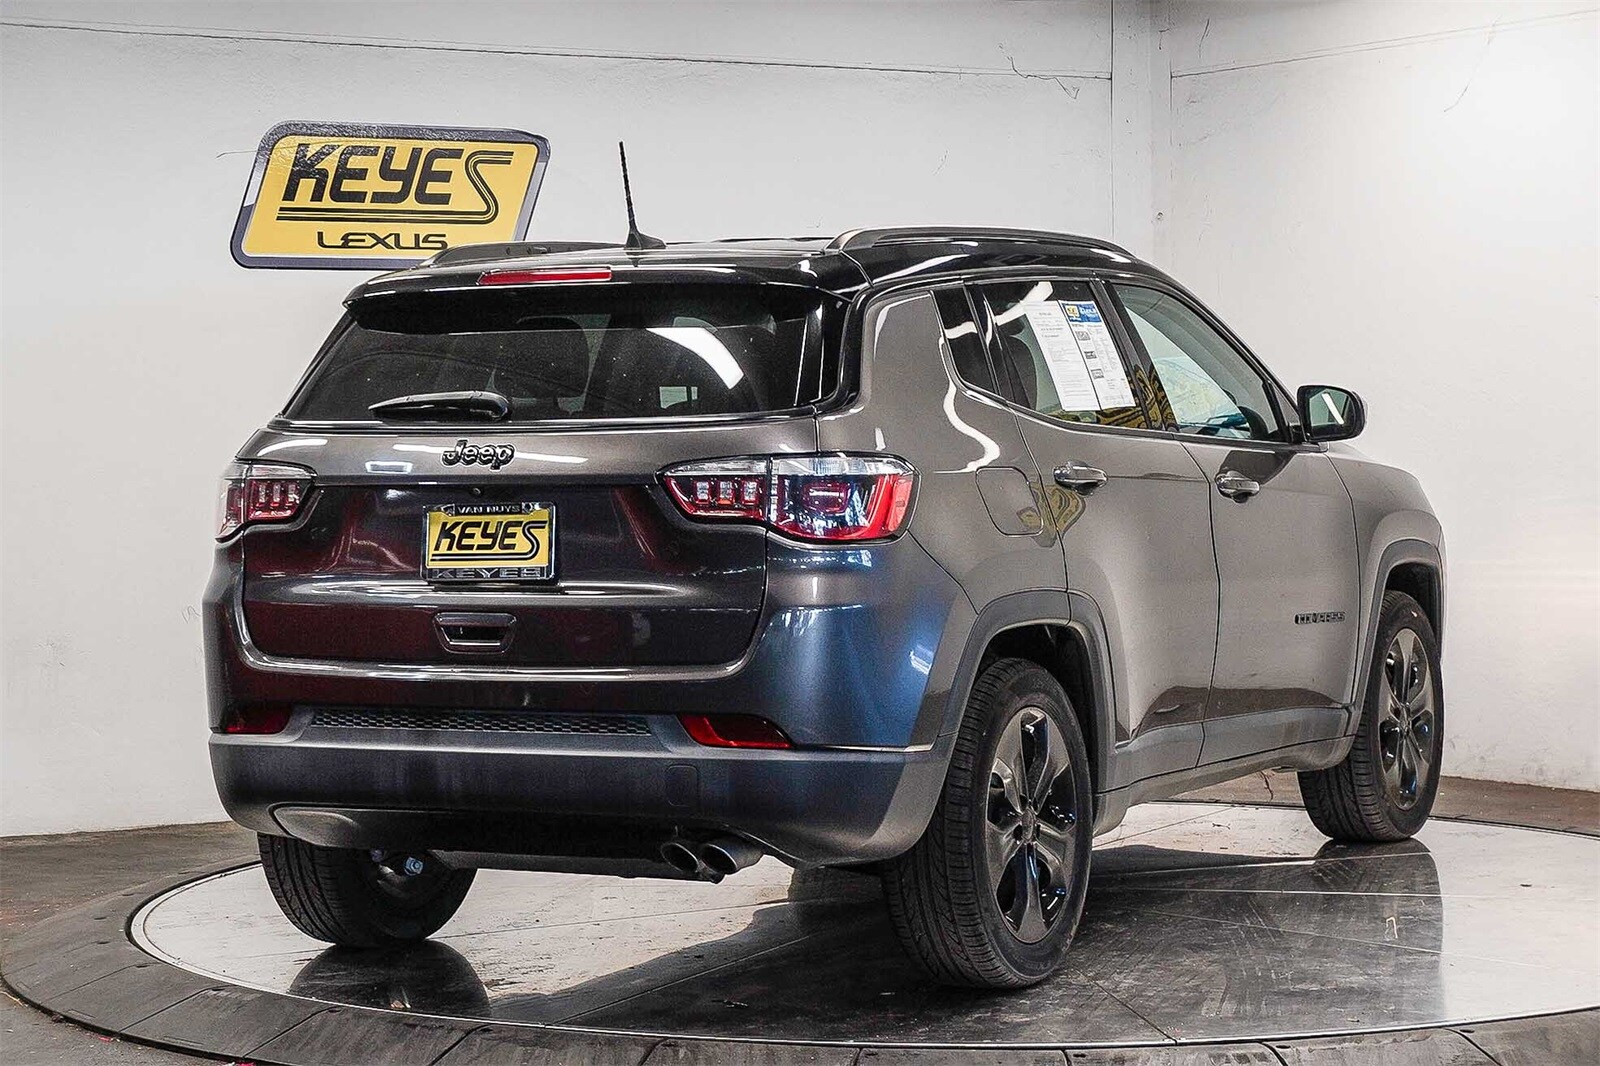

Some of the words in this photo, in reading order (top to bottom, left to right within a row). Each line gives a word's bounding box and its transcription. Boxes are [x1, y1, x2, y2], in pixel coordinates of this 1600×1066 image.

[276, 143, 514, 224] KEYES
[317, 231, 448, 250] LEXUS
[442, 439, 515, 470] Jeep
[457, 506, 483, 514] VAN
[486, 505, 520, 513] NUYS
[430, 521, 547, 561] KEYES
[432, 568, 541, 578] KEYES
